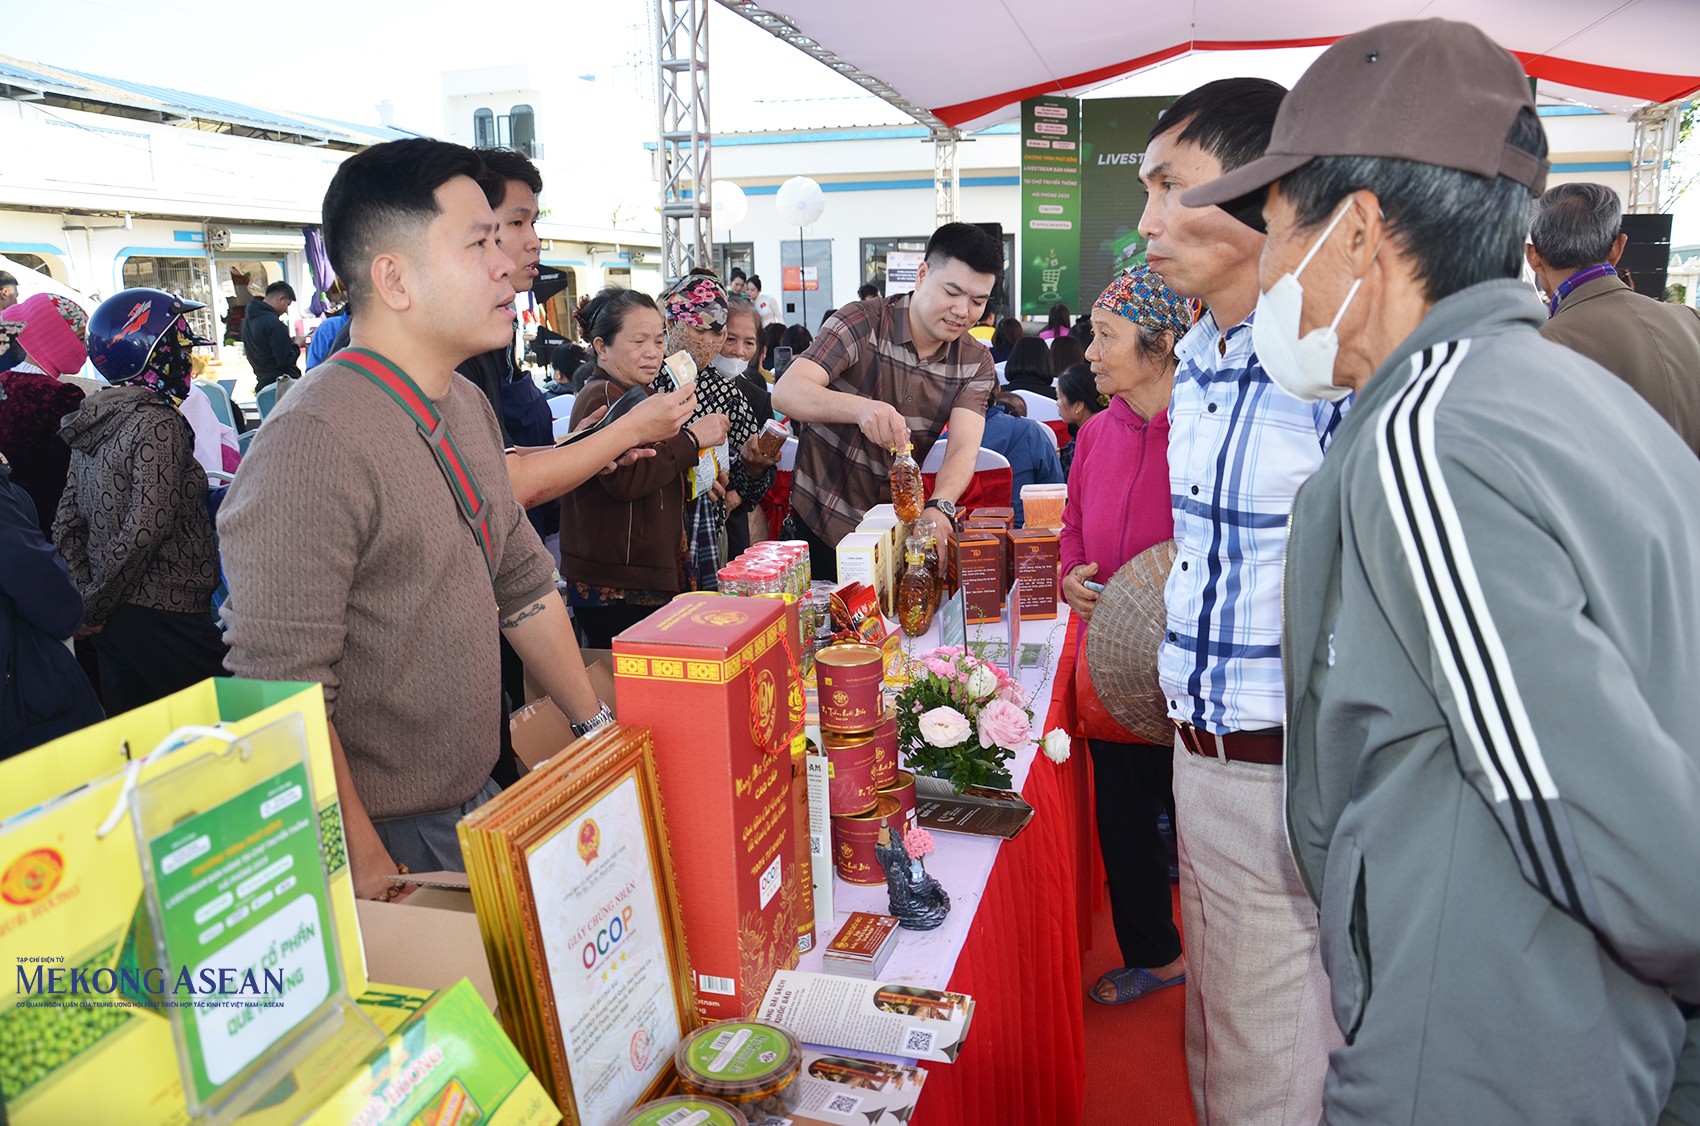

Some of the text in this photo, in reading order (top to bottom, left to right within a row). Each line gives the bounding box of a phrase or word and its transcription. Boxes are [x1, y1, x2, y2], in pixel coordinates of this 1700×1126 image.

[1098, 152, 1144, 165] LIVEST
[281, 921, 316, 958] PHẦN
[582, 905, 632, 969] OCOP
